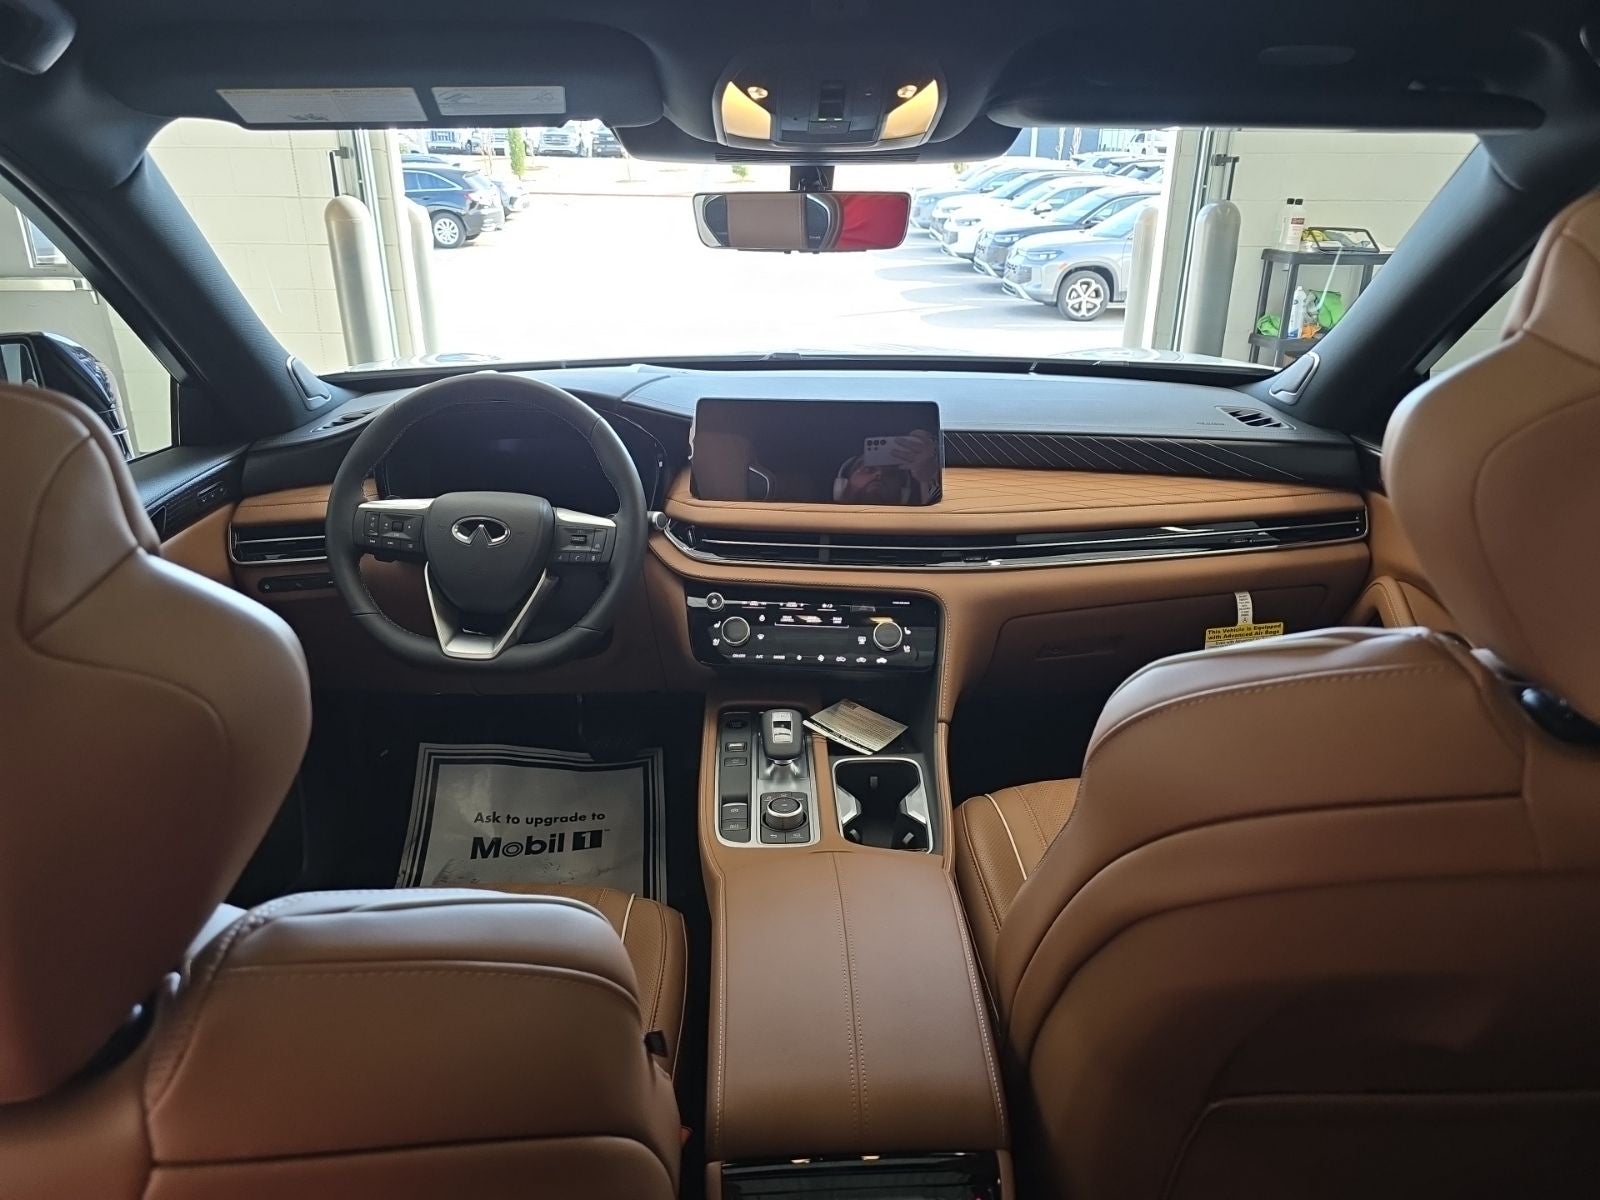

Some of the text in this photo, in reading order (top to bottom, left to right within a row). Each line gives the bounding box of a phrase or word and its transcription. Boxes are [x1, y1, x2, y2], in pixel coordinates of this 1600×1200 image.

[474, 811, 606, 827] Ask to upgrade to
[470, 832, 565, 860] Mobil
